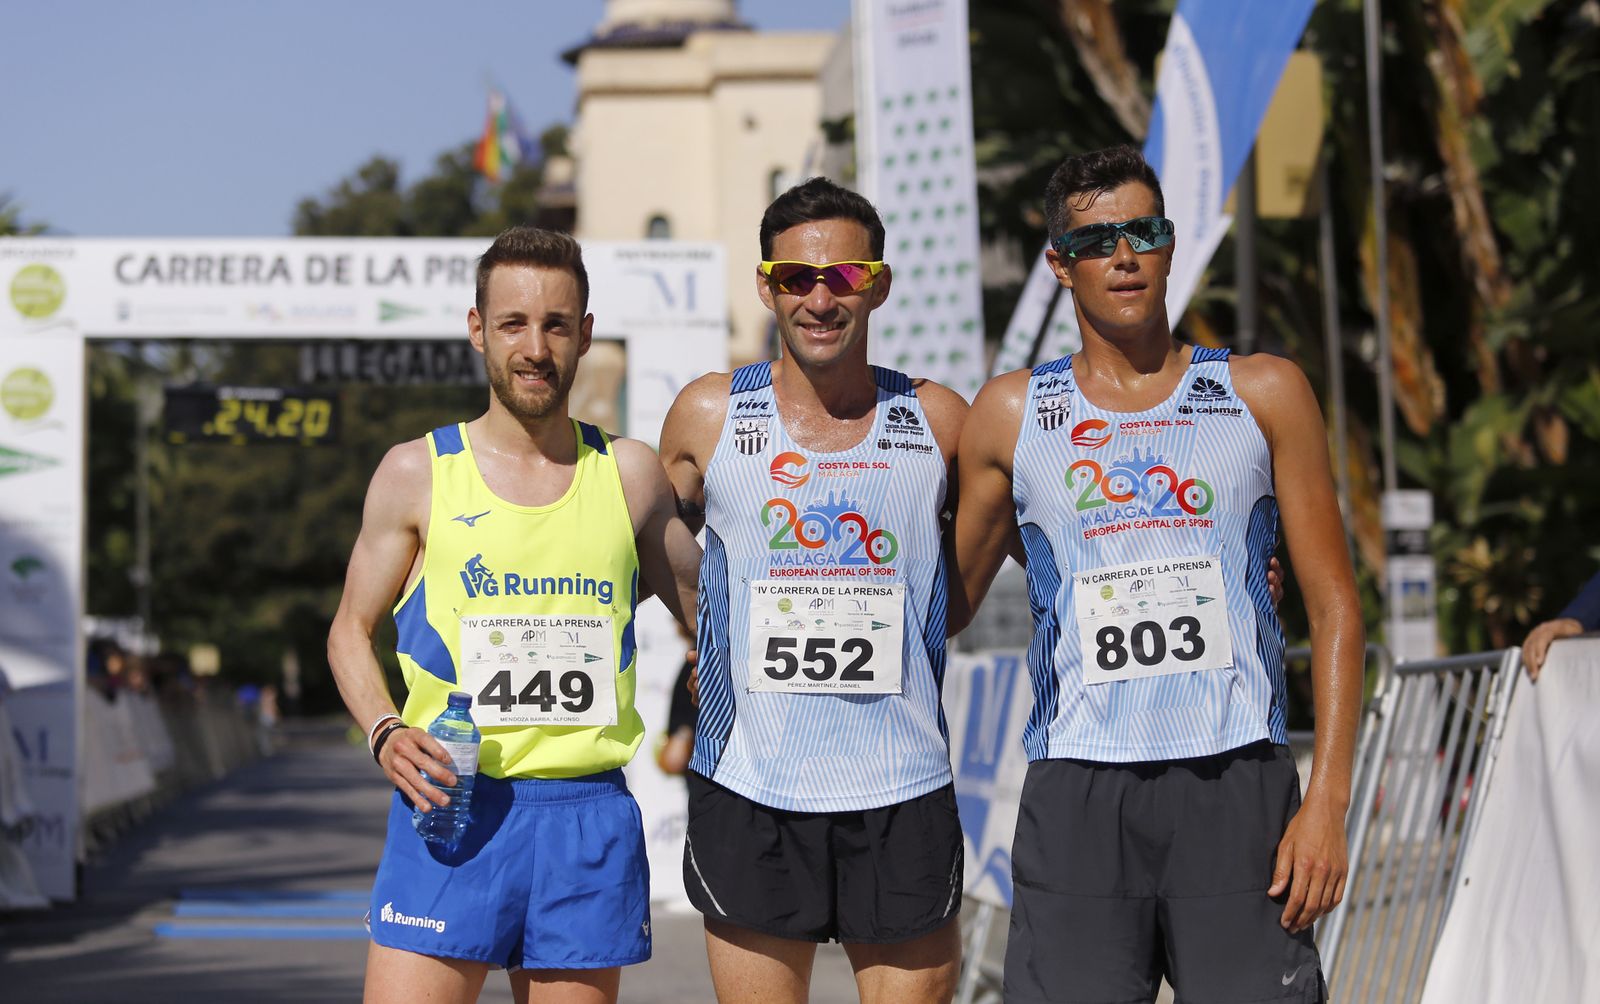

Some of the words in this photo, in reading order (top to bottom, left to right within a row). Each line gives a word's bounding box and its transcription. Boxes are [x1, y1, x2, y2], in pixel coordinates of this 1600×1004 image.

[115, 254, 292, 285] CARRERA
[306, 255, 352, 285] DE
[365, 255, 412, 286] LA
[424, 256, 478, 286] PR
[736, 398, 770, 411] vive
[1196, 405, 1243, 415] cajamar
[1119, 420, 1152, 429] COSTA
[894, 440, 934, 452] cajamar
[817, 462, 850, 470] COSTA
[852, 461, 871, 469] DEL
[1064, 459, 1214, 516] 2020
[1080, 504, 1150, 528] MÁLAGA
[1133, 519, 1171, 529] CAPITAL
[1173, 519, 1187, 528] OF
[1189, 518, 1214, 529] SPORT
[760, 497, 899, 565] 2020
[769, 551, 837, 566] MÁLAGA
[769, 568, 819, 577] EUROPEAN
[821, 568, 857, 577] CAPITAL
[858, 567, 872, 577] OF
[1081, 577, 1091, 586] IV
[1092, 568, 1139, 584] CARRERA
[1140, 566, 1155, 577] DE
[1157, 564, 1171, 575] LA
[1172, 560, 1212, 572] PRENSA
[504, 573, 613, 605] Running
[758, 586, 768, 595] IV
[770, 586, 820, 596] CARRERA
[821, 586, 836, 596] DE
[838, 587, 852, 596] LA
[853, 587, 893, 597] PRENSA
[1129, 578, 1156, 593] APM
[808, 598, 835, 610] APM
[468, 619, 479, 629] IV
[480, 618, 530, 628] CARRERA
[533, 618, 548, 628] DE
[549, 618, 563, 628] LA
[564, 619, 603, 629] PRENSA
[520, 629, 547, 643] APM
[1096, 615, 1206, 671] 803
[763, 636, 874, 682] 552
[477, 670, 595, 713] 449
[499, 715, 529, 723] MENDOZA
[553, 715, 580, 723] ALFONSO
[394, 911, 446, 933] Running
